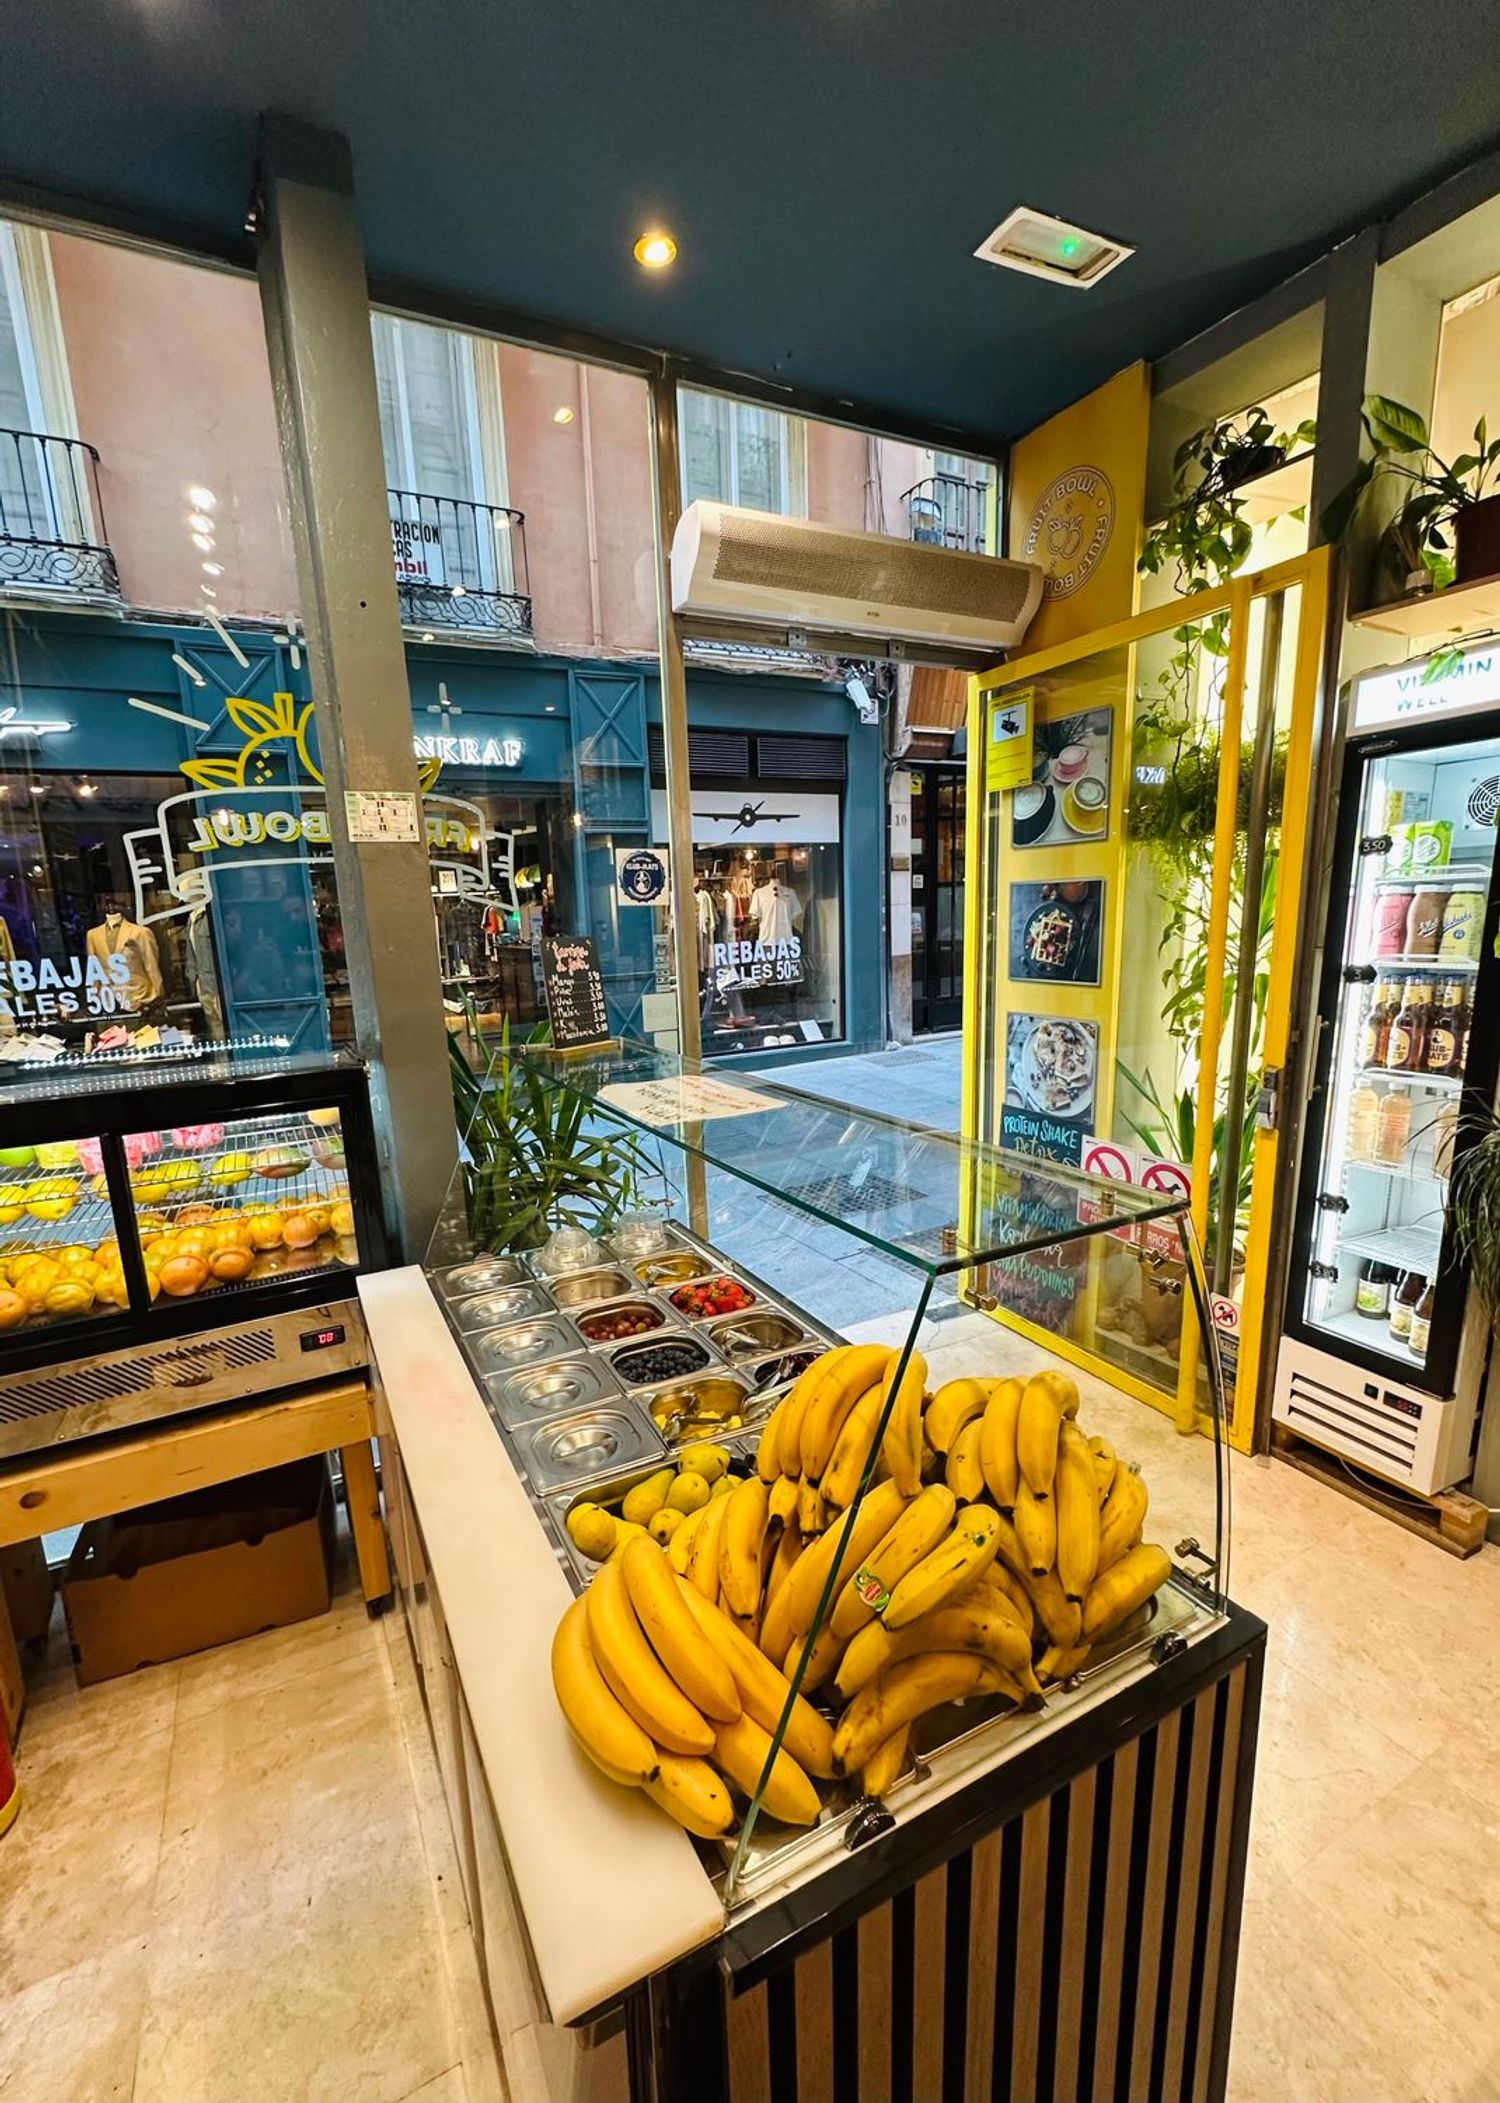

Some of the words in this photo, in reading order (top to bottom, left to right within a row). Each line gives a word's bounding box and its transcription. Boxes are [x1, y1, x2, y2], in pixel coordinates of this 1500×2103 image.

[1026, 497, 1053, 555] FRUIT
[1055, 475, 1100, 501] BOWL
[390, 520, 440, 544] RACION
[393, 540, 413, 558] AS
[1078, 515, 1109, 578] FRUIT
[1043, 573, 1075, 593] BOW
[1397, 695, 1448, 712] WELL
[895, 814, 907, 826] 10
[714, 936, 802, 966] REBAJAS
[716, 963, 773, 982] SALES
[776, 960, 800, 980] 50%
[86, 985, 131, 1015] 50%
[1004, 1115, 1040, 1136] PROTEIN
[1041, 1120, 1078, 1149] SHAKE
[1020, 1256, 1075, 1300] PUDDINGS
